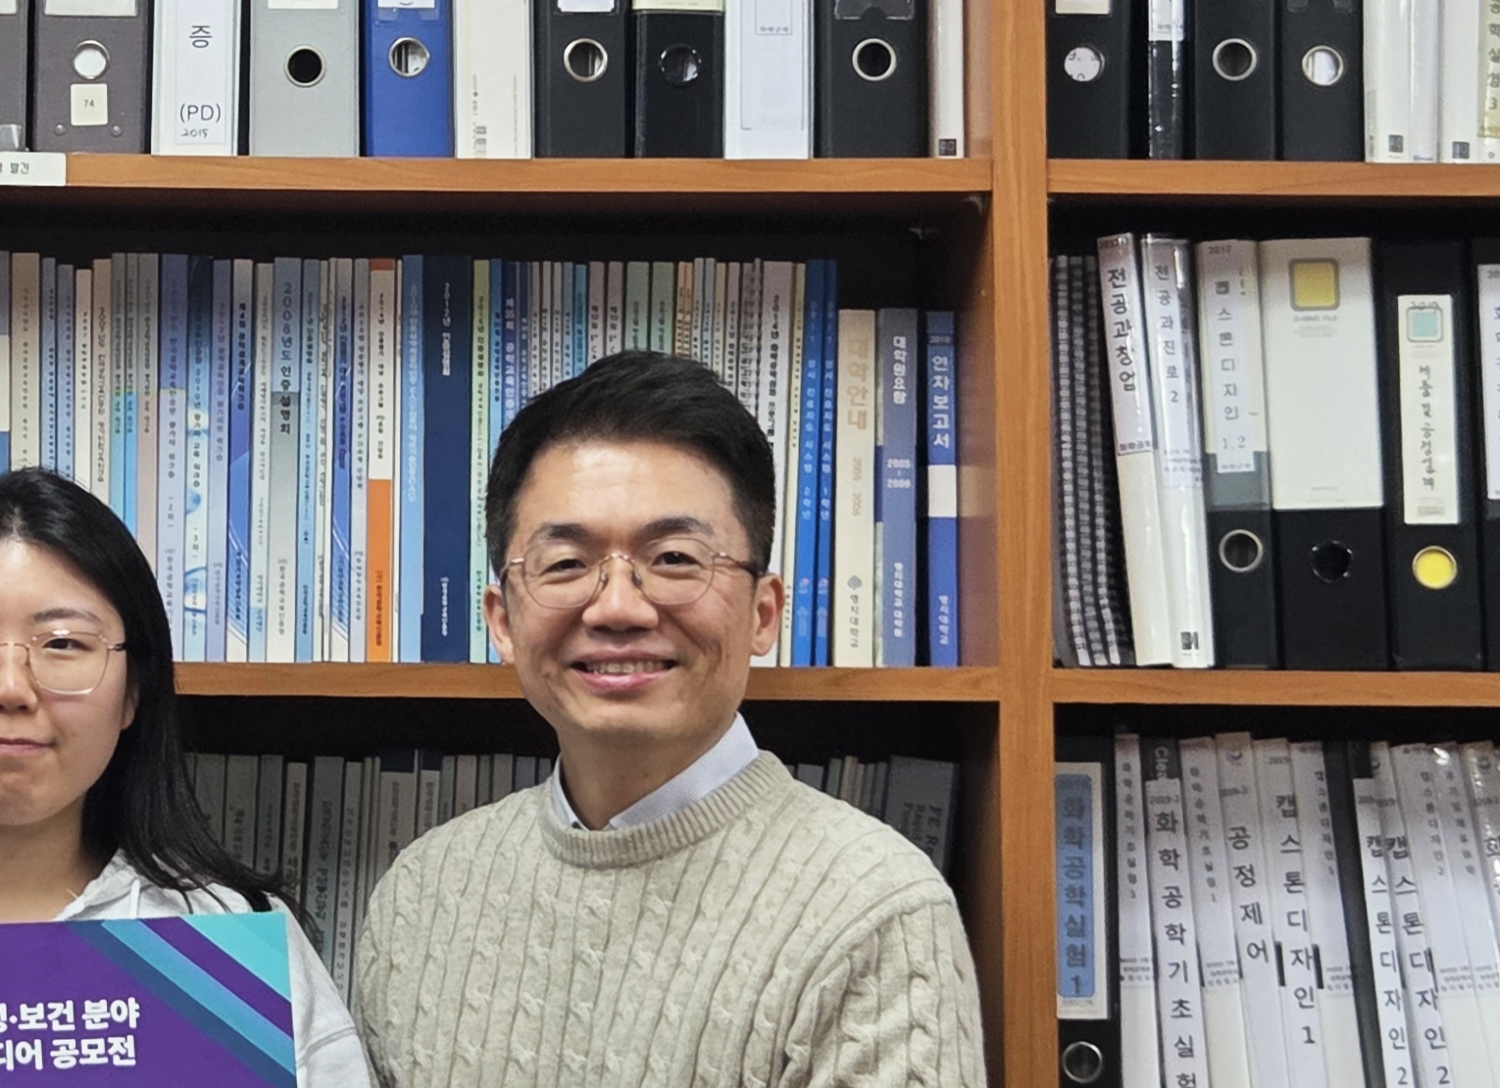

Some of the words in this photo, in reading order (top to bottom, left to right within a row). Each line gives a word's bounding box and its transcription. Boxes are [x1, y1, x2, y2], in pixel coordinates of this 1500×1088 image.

[189, 25, 213, 49] 증
[179, 103, 222, 124] (PD)
[932, 355, 950, 450] 연차보고서
[1228, 826, 1269, 965] 공정제어
[81, 997, 141, 1030] 분야
[49, 1035, 138, 1069] 공모전
